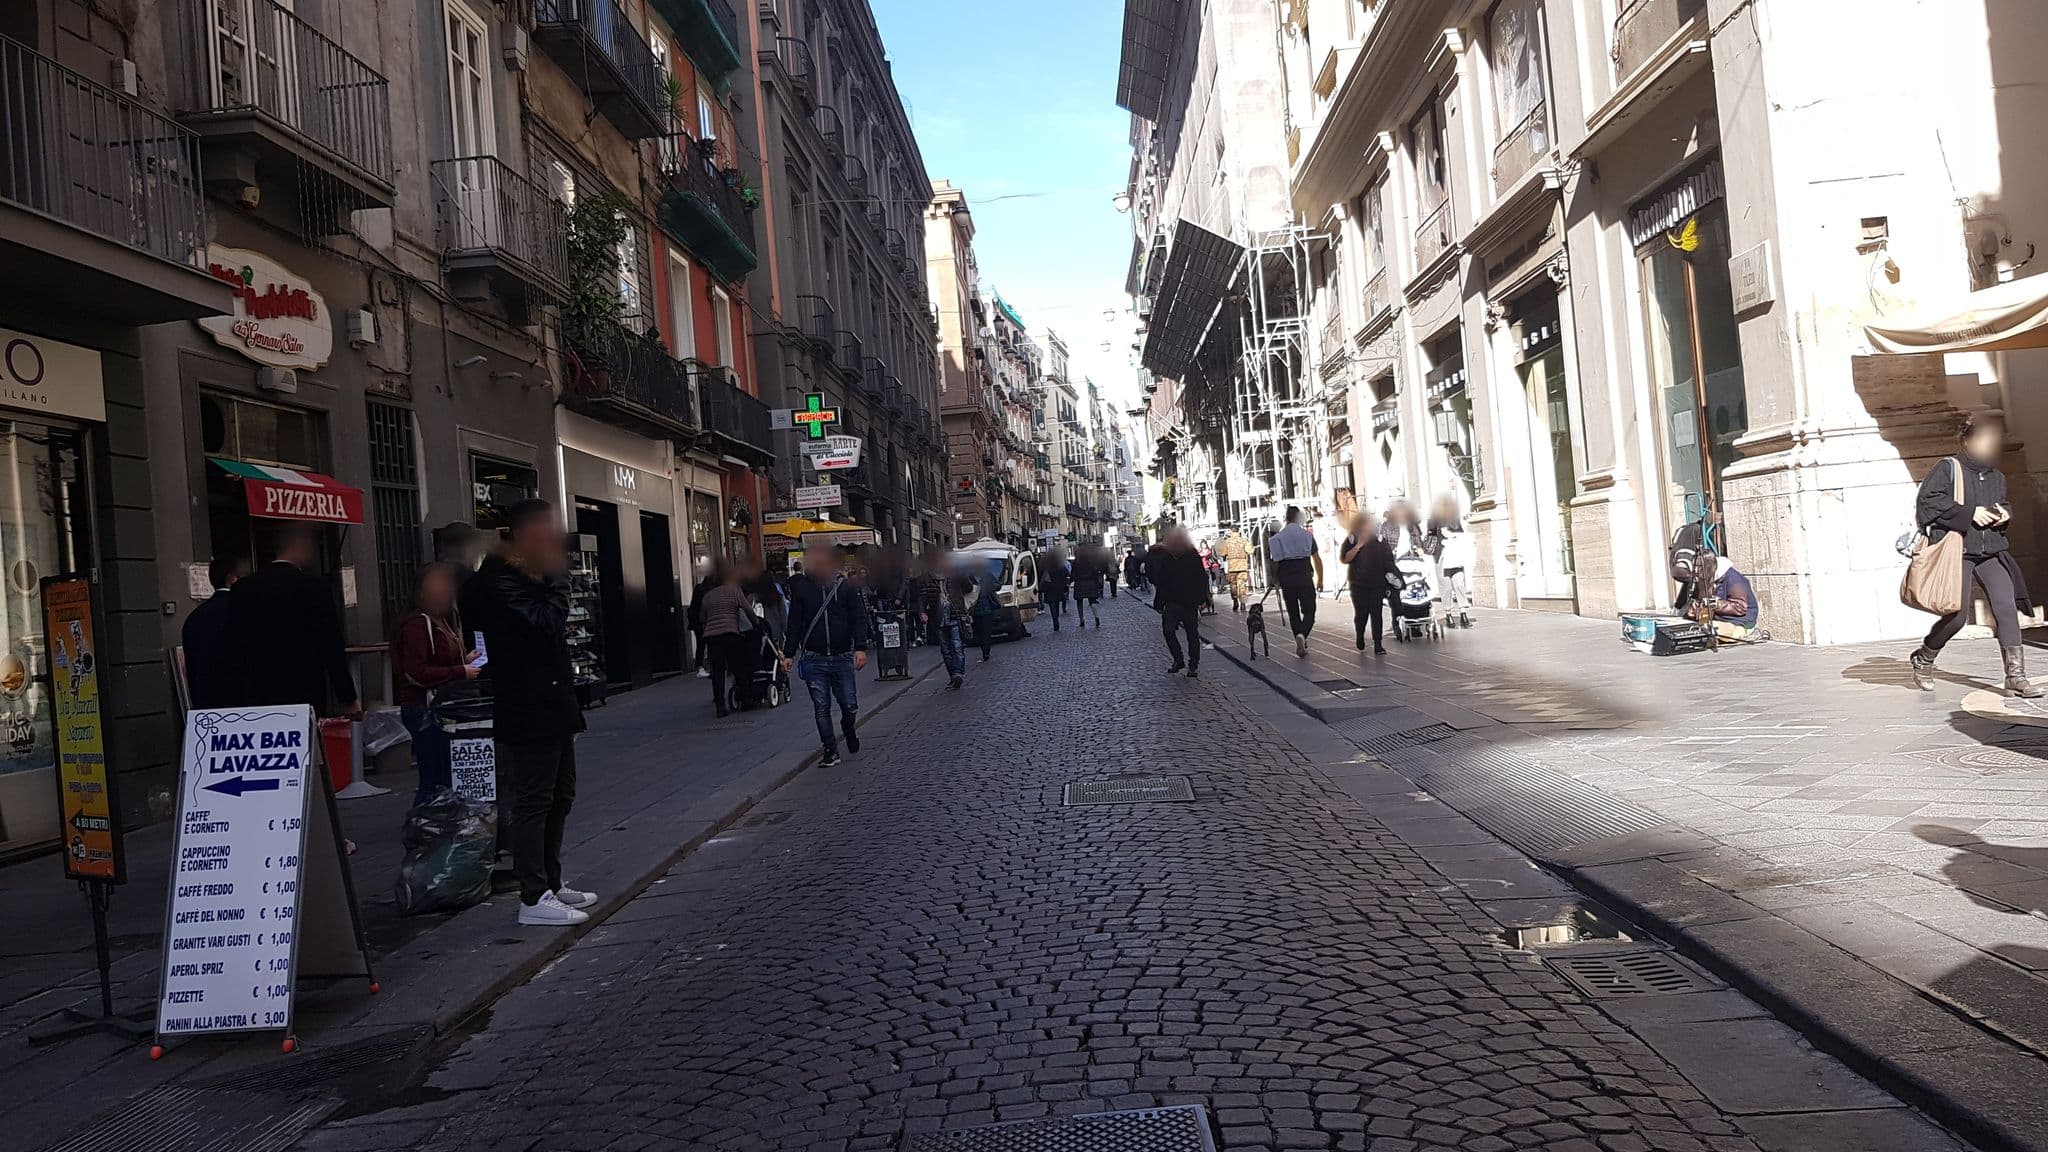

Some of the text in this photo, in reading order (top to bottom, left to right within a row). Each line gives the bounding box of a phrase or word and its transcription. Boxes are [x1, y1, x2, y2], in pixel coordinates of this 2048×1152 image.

[0, 338, 44, 386] O
[4, 389, 47, 404] ILANO
[264, 486, 349, 519] PIZZERIA
[210, 731, 301, 752] MAX BAR
[452, 744, 493, 755] SALSA
[209, 752, 300, 774] LAVAZZA
[184, 821, 229, 834] E CORNETTO
[268, 818, 301, 832] € 1,50
[182, 845, 231, 859] CAPPUCCINO
[180, 858, 228, 872] E CORNETTO
[265, 856, 297, 870] € 1,80
[203, 883, 234, 897] FREDDO
[262, 881, 295, 895] € 1,00
[201, 910, 215, 922] DEL
[216, 908, 245, 921] NONNO
[260, 906, 293, 921] € 1,50
[173, 934, 251, 950] GRANITE VARI GUSTI
[257, 932, 291, 947] € 1,00
[170, 962, 224, 977] APEROL SPRIZ
[255, 958, 289, 973] € 1,00
[168, 990, 204, 1004] PIZZETTE
[252, 985, 287, 999] € 1,00
[166, 1014, 247, 1031] PANINI ALLA PIASTRA
[250, 1012, 285, 1026] € 3,00
